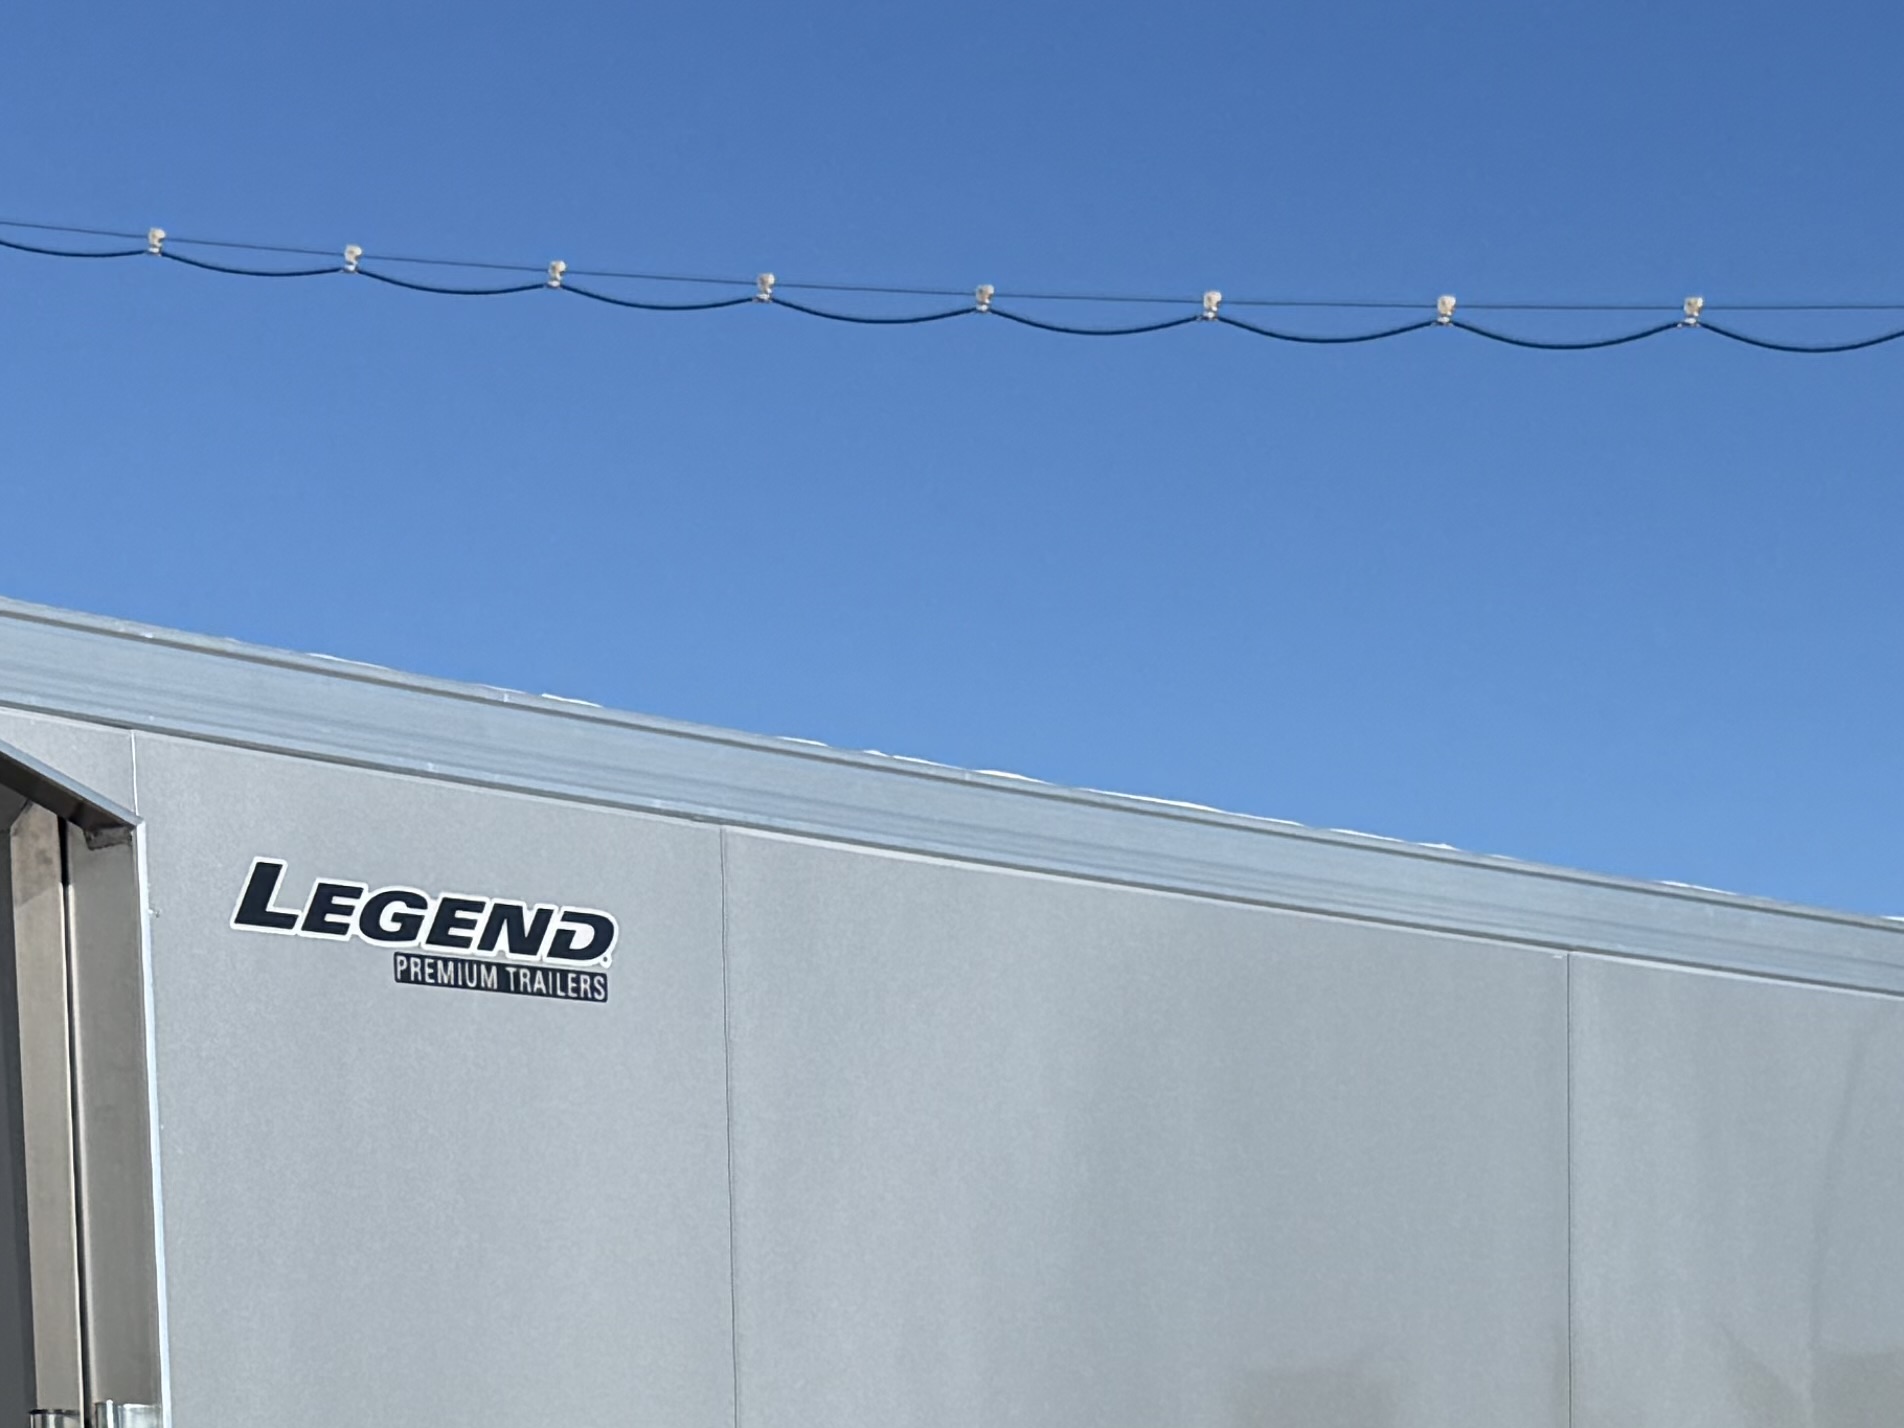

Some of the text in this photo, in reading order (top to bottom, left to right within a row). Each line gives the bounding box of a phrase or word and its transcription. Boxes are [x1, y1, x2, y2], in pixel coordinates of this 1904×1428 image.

[232, 860, 617, 963] LEGEND
[395, 954, 607, 1001] PREMIUM TRAILERS
